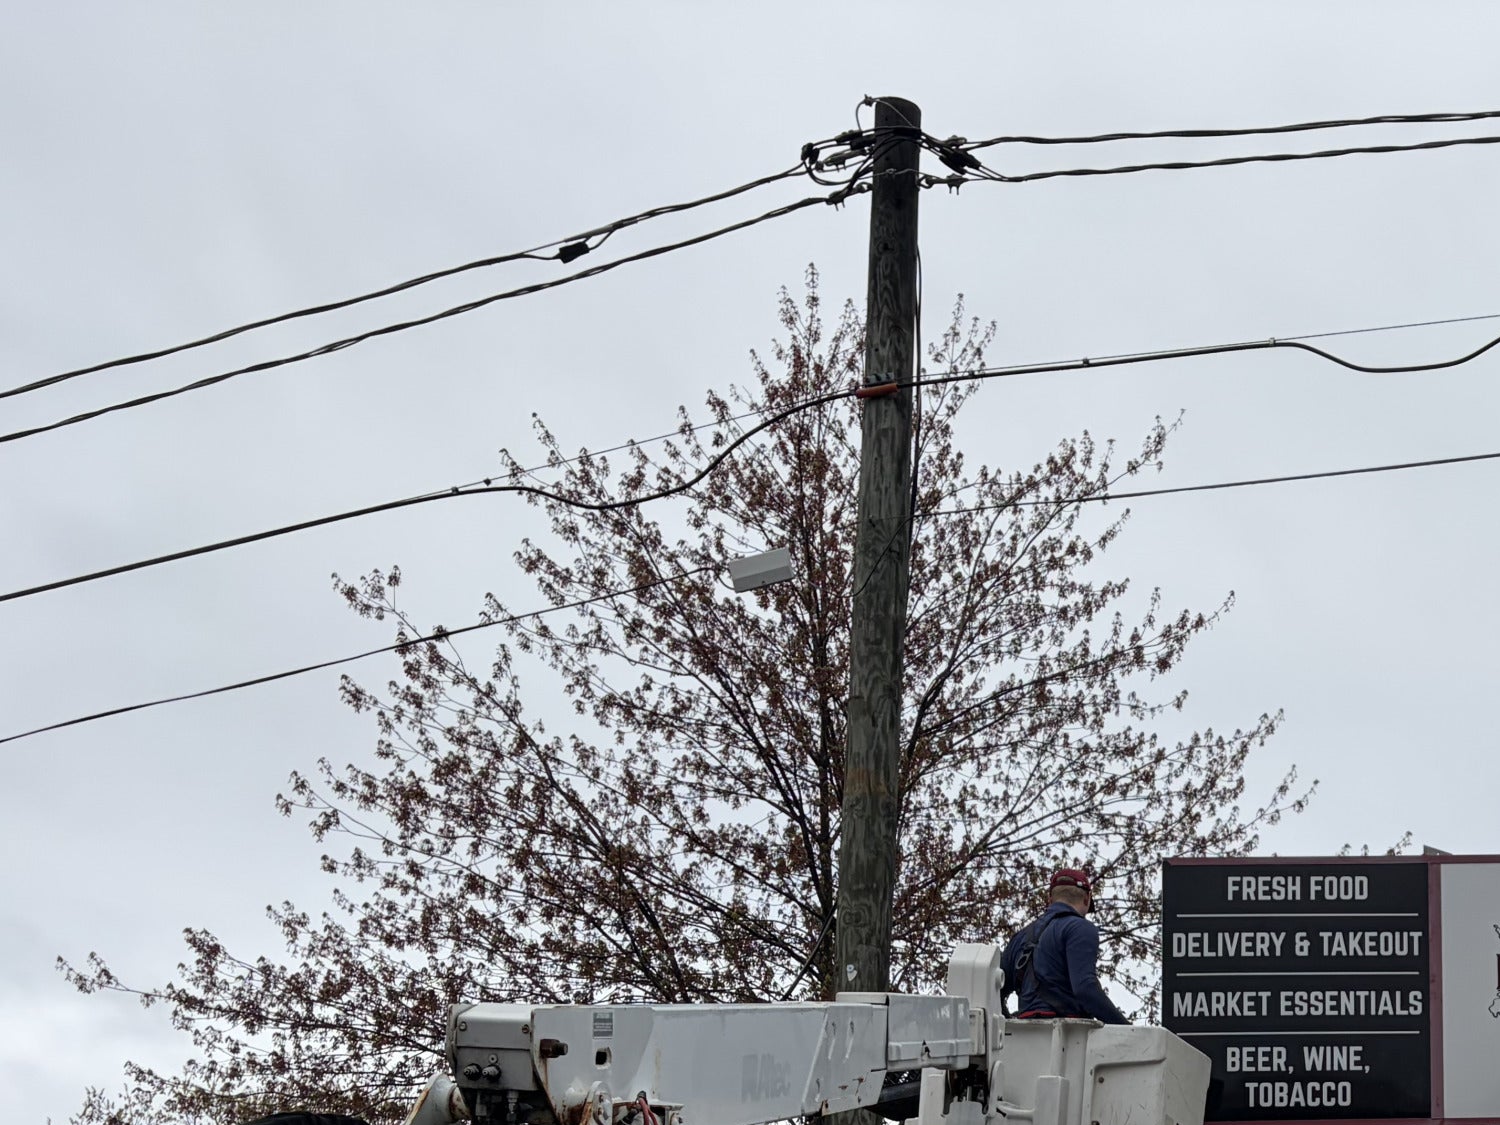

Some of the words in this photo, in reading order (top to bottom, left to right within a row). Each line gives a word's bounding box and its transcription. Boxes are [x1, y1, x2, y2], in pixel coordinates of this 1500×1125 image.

[1227, 876, 1301, 901] FRESH
[1309, 875, 1369, 900] FOOD
[1172, 932, 1287, 958] DELIVERY
[1294, 931, 1311, 957] &
[1319, 931, 1423, 956] TAKEOUT
[1173, 991, 1272, 1017] MARKET
[1280, 990, 1423, 1016] ESSENTIALS
[1226, 1046, 1295, 1075] BEER,
[1303, 1045, 1371, 1074] WINE,
[1245, 1081, 1352, 1108] TOBACCO
